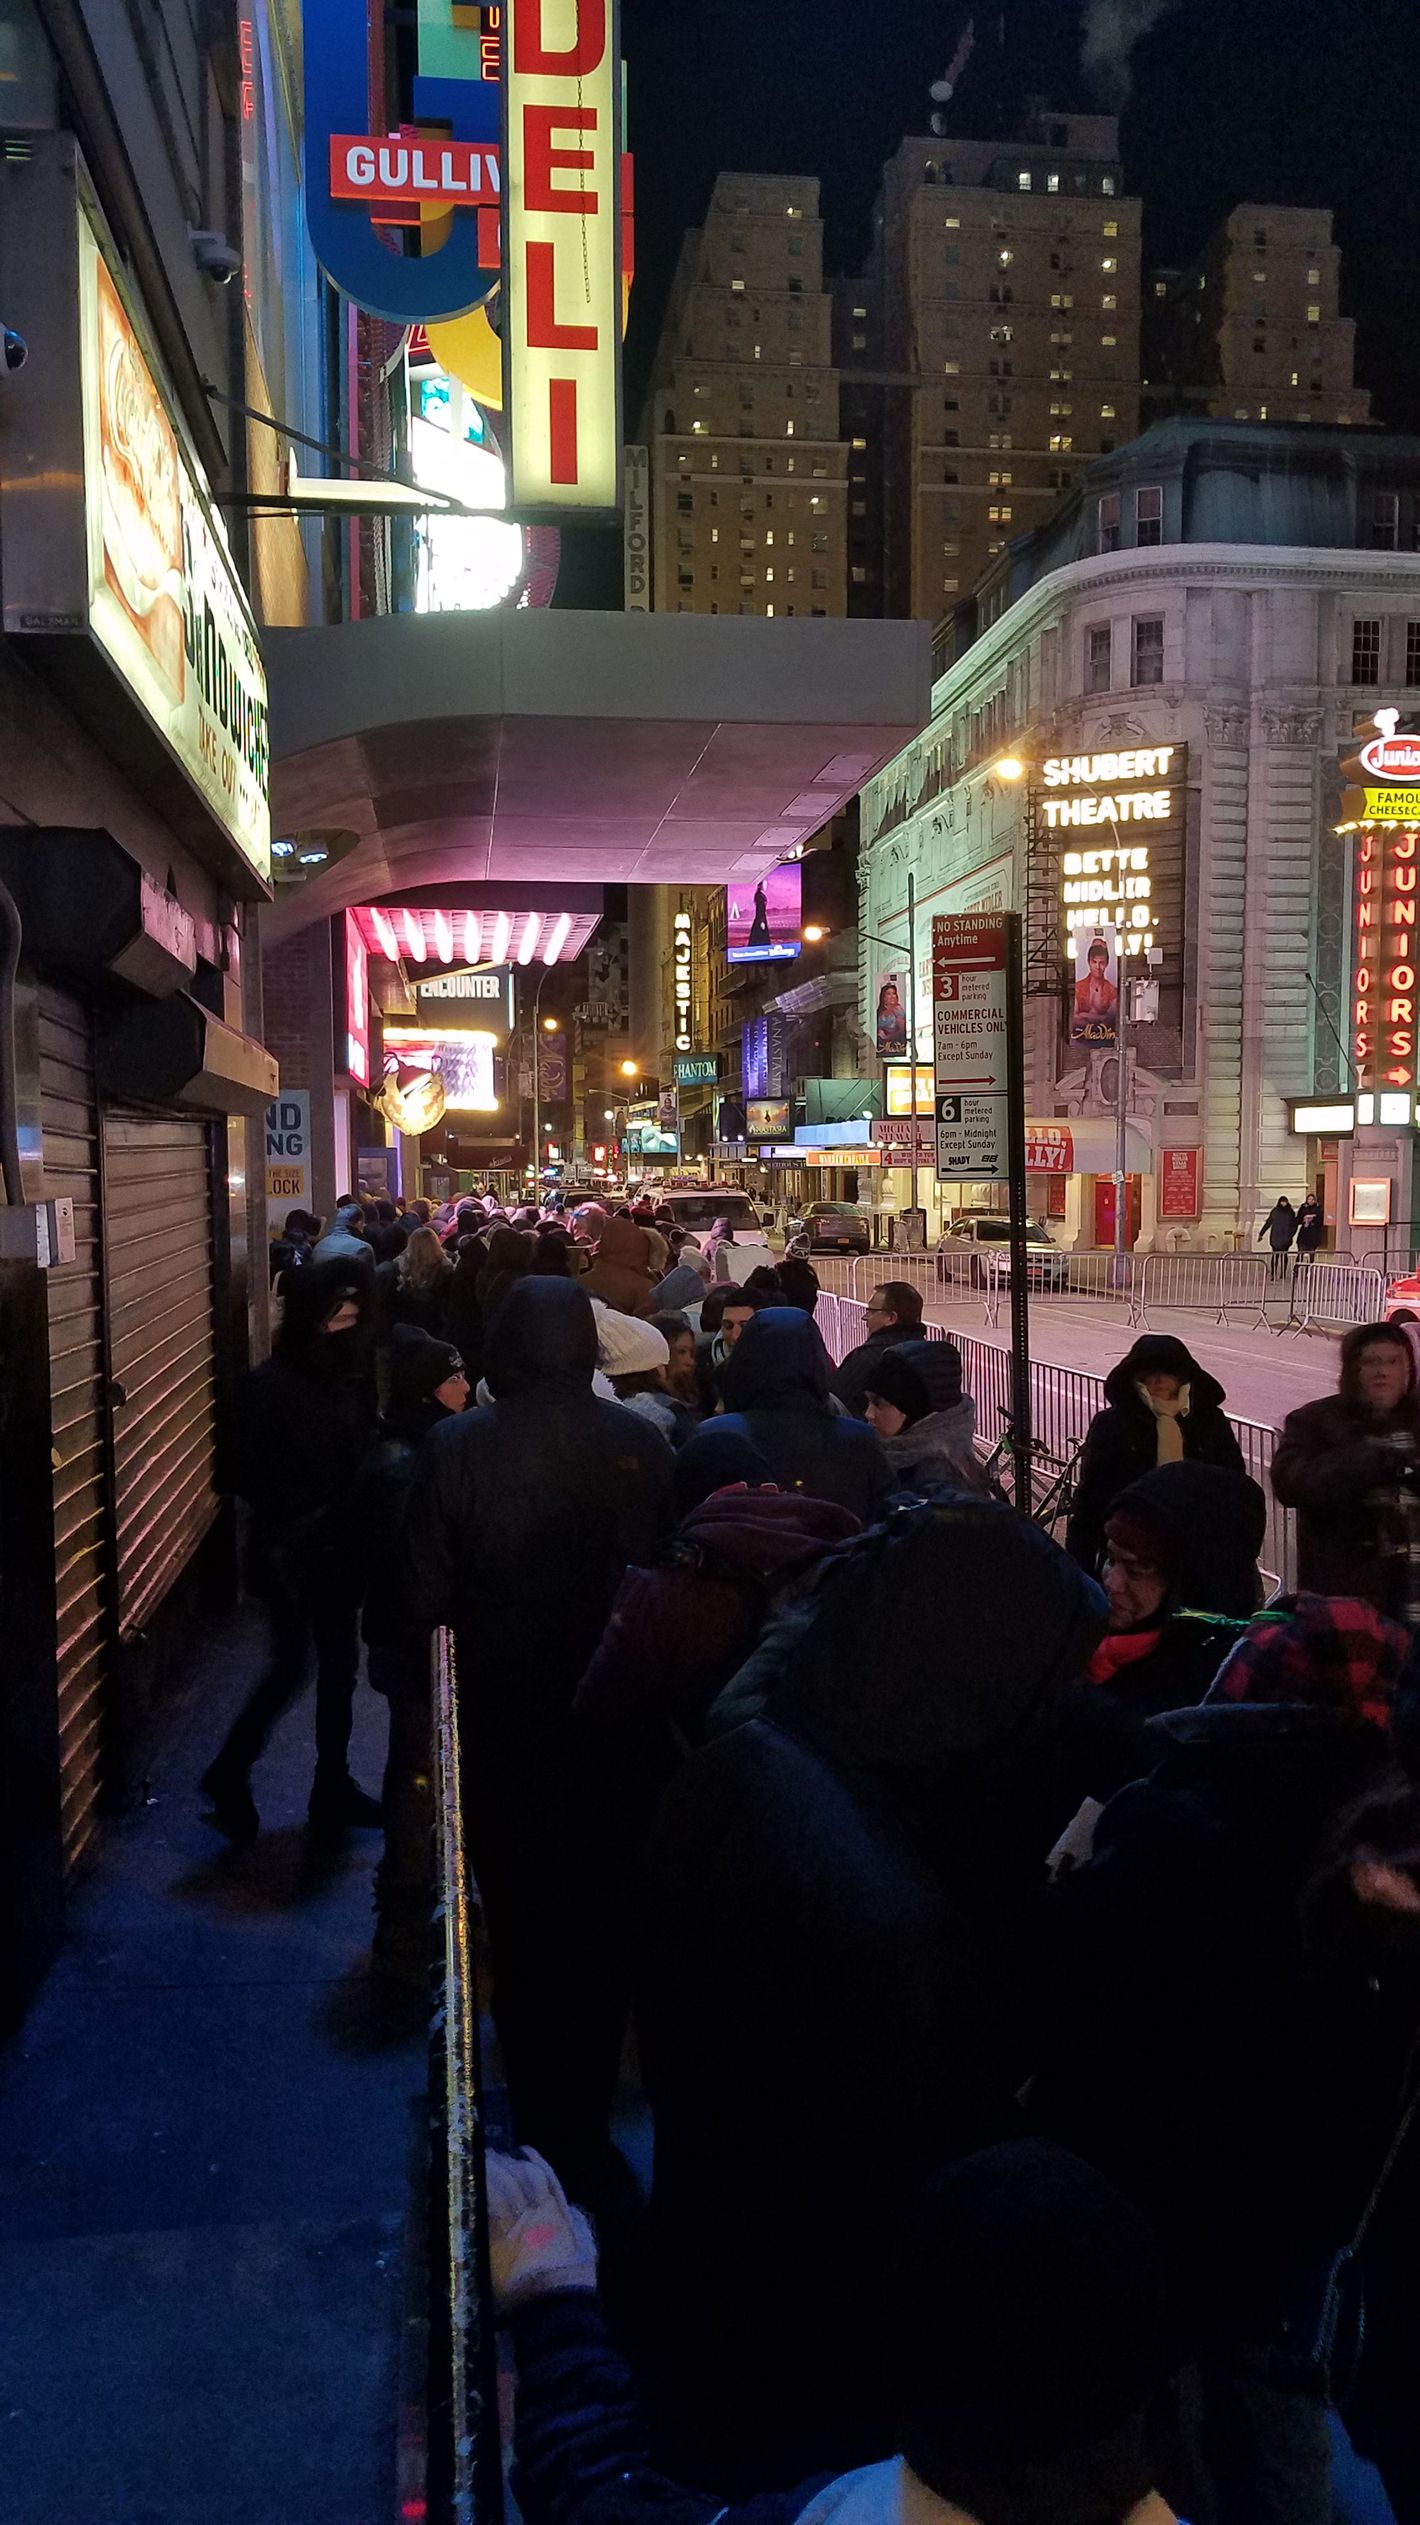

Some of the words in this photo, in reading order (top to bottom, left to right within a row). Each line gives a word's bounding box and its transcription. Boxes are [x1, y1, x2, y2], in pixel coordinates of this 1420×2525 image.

[514, 0, 606, 485] DELI
[624, 448, 647, 594] MILFORD
[1043, 747, 1174, 787] SHUBERT
[1042, 790, 1171, 828] THEATRE
[1369, 804, 1420, 816] CHEESEC
[1063, 847, 1149, 876] BETTE
[937, 921, 951, 933] NO
[953, 917, 1003, 932] STANDING
[937, 934, 978, 948] Anytime
[1356, 836, 1373, 1057] JUNIORS
[1391, 833, 1419, 1057] JUNIORS
[421, 975, 500, 998] ENCOUNTER
[674, 913, 691, 1050] MAJESTIC
[940, 976, 953, 998] 3
[962, 982, 990, 991] metered
[962, 991, 987, 1001] parking
[937, 1008, 1004, 1021] COMMERCIAL
[937, 1022, 983, 1035] VEHICLES
[938, 1041, 953, 1050] 7am
[961, 1041, 977, 1050] 6pm
[938, 1051, 964, 1061] Except
[966, 1051, 993, 1061] Sunday
[674, 1060, 717, 1079] PHANTOM
[942, 1098, 955, 1121] 6
[964, 1099, 979, 1107] hour
[964, 1107, 992, 1115] metered
[964, 1115, 989, 1123] parking
[940, 1130, 957, 1139] 6pm
[964, 1128, 997, 1138] Midnight
[266, 1133, 303, 1156] NG
[940, 1140, 966, 1150] Except
[968, 1140, 995, 1150] Sunday
[948, 1156, 970, 1165] SHADY
[269, 1178, 300, 1195] OCK
